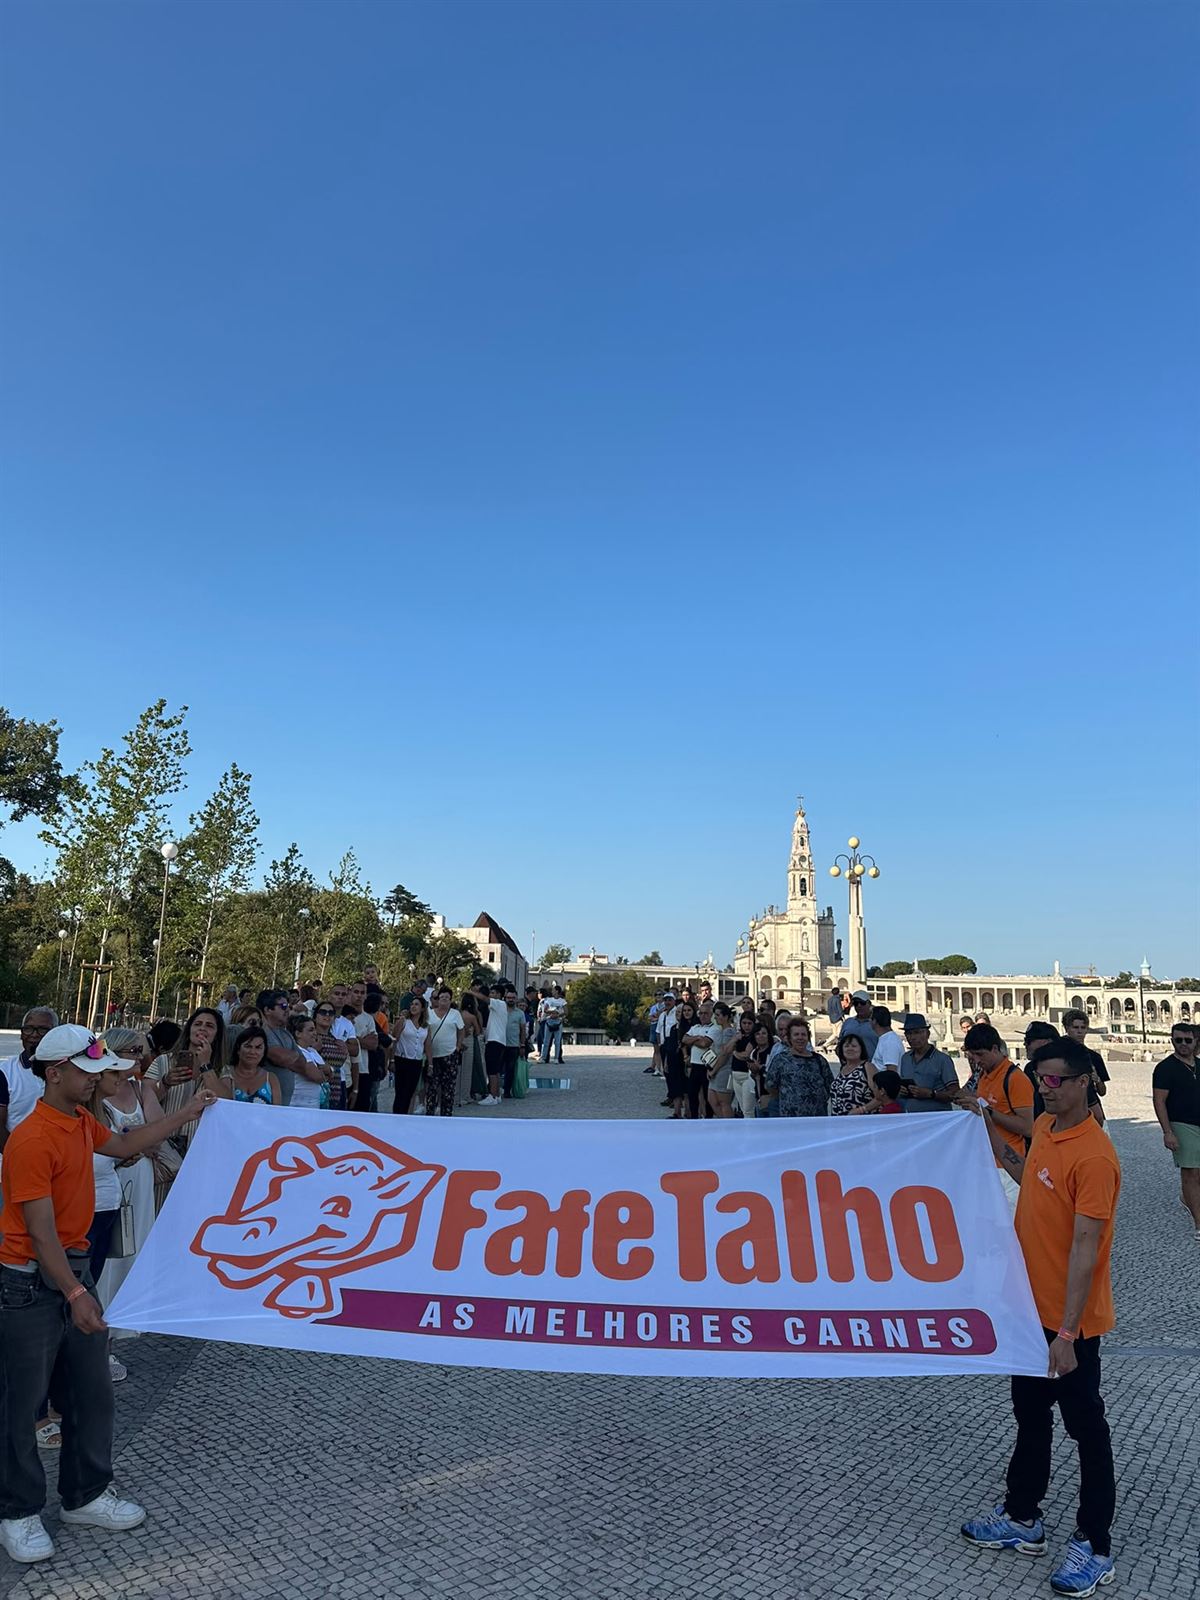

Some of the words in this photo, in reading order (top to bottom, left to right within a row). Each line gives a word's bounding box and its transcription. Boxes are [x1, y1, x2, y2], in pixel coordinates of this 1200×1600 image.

[418, 1300, 476, 1331] AS
[504, 1304, 754, 1345] MELHORES
[783, 1316, 973, 1349] CARNES
